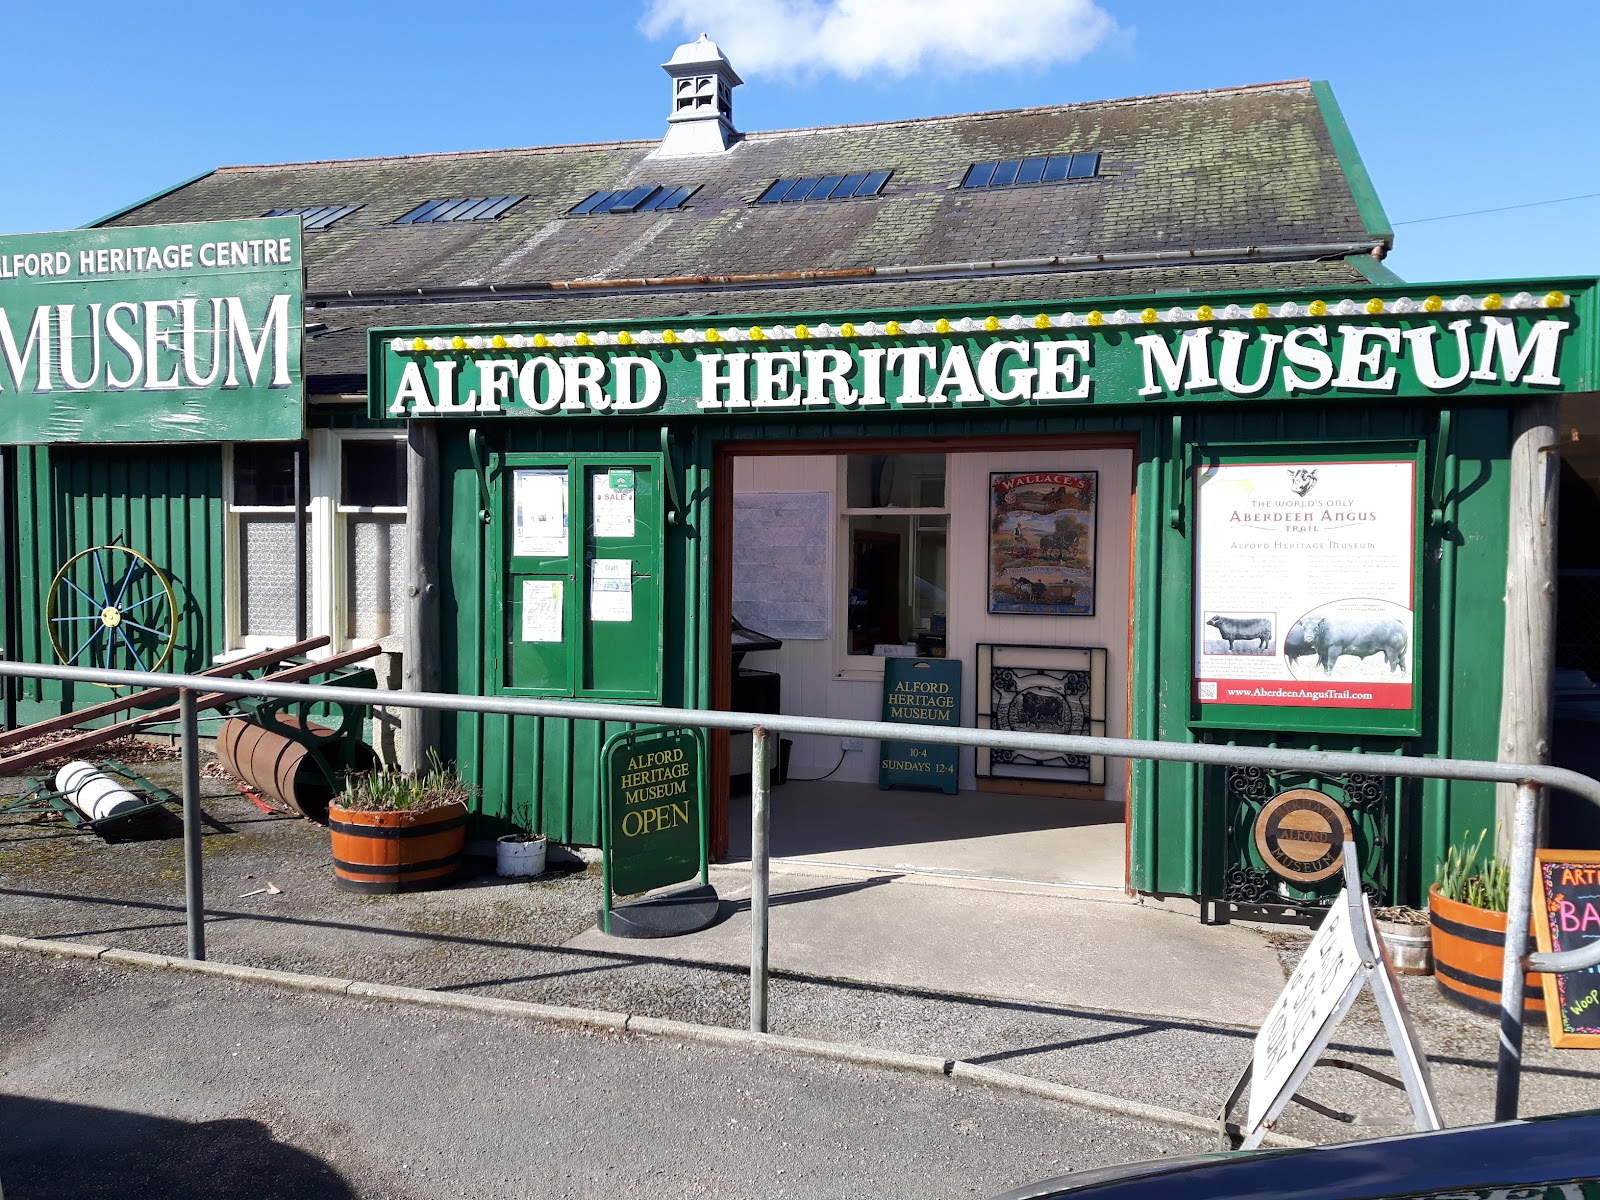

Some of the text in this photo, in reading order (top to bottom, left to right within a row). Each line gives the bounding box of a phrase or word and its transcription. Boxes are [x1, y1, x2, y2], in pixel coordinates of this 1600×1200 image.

[79, 244, 193, 275] HERITAGE
[199, 238, 292, 267] CENTRE
[0, 294, 293, 393] MUSEUM
[389, 315, 1570, 414] ALFORD HERITAGE MUSEUM
[1002, 475, 1086, 490] WALLACE'S
[604, 493, 625, 501] SALE
[1251, 499, 1271, 508] THE
[1275, 499, 1323, 508] WORLD'S
[894, 681, 949, 694] ALFORD
[1227, 686, 1373, 702] www.AberdeenAngusTrail.com
[887, 693, 954, 708] HERITAGE
[890, 707, 950, 721] MUSEUM
[627, 748, 684, 771] ALFORD
[909, 748, 928, 758] 10-4
[881, 759, 955, 774] SUNDAYS 12-4
[620, 763, 690, 789] HERITAGE
[625, 780, 687, 805] MUSEUM
[622, 800, 690, 837] OPEN
[1280, 830, 1328, 842] ALFORD
[1272, 848, 1335, 873] MUSEUM
